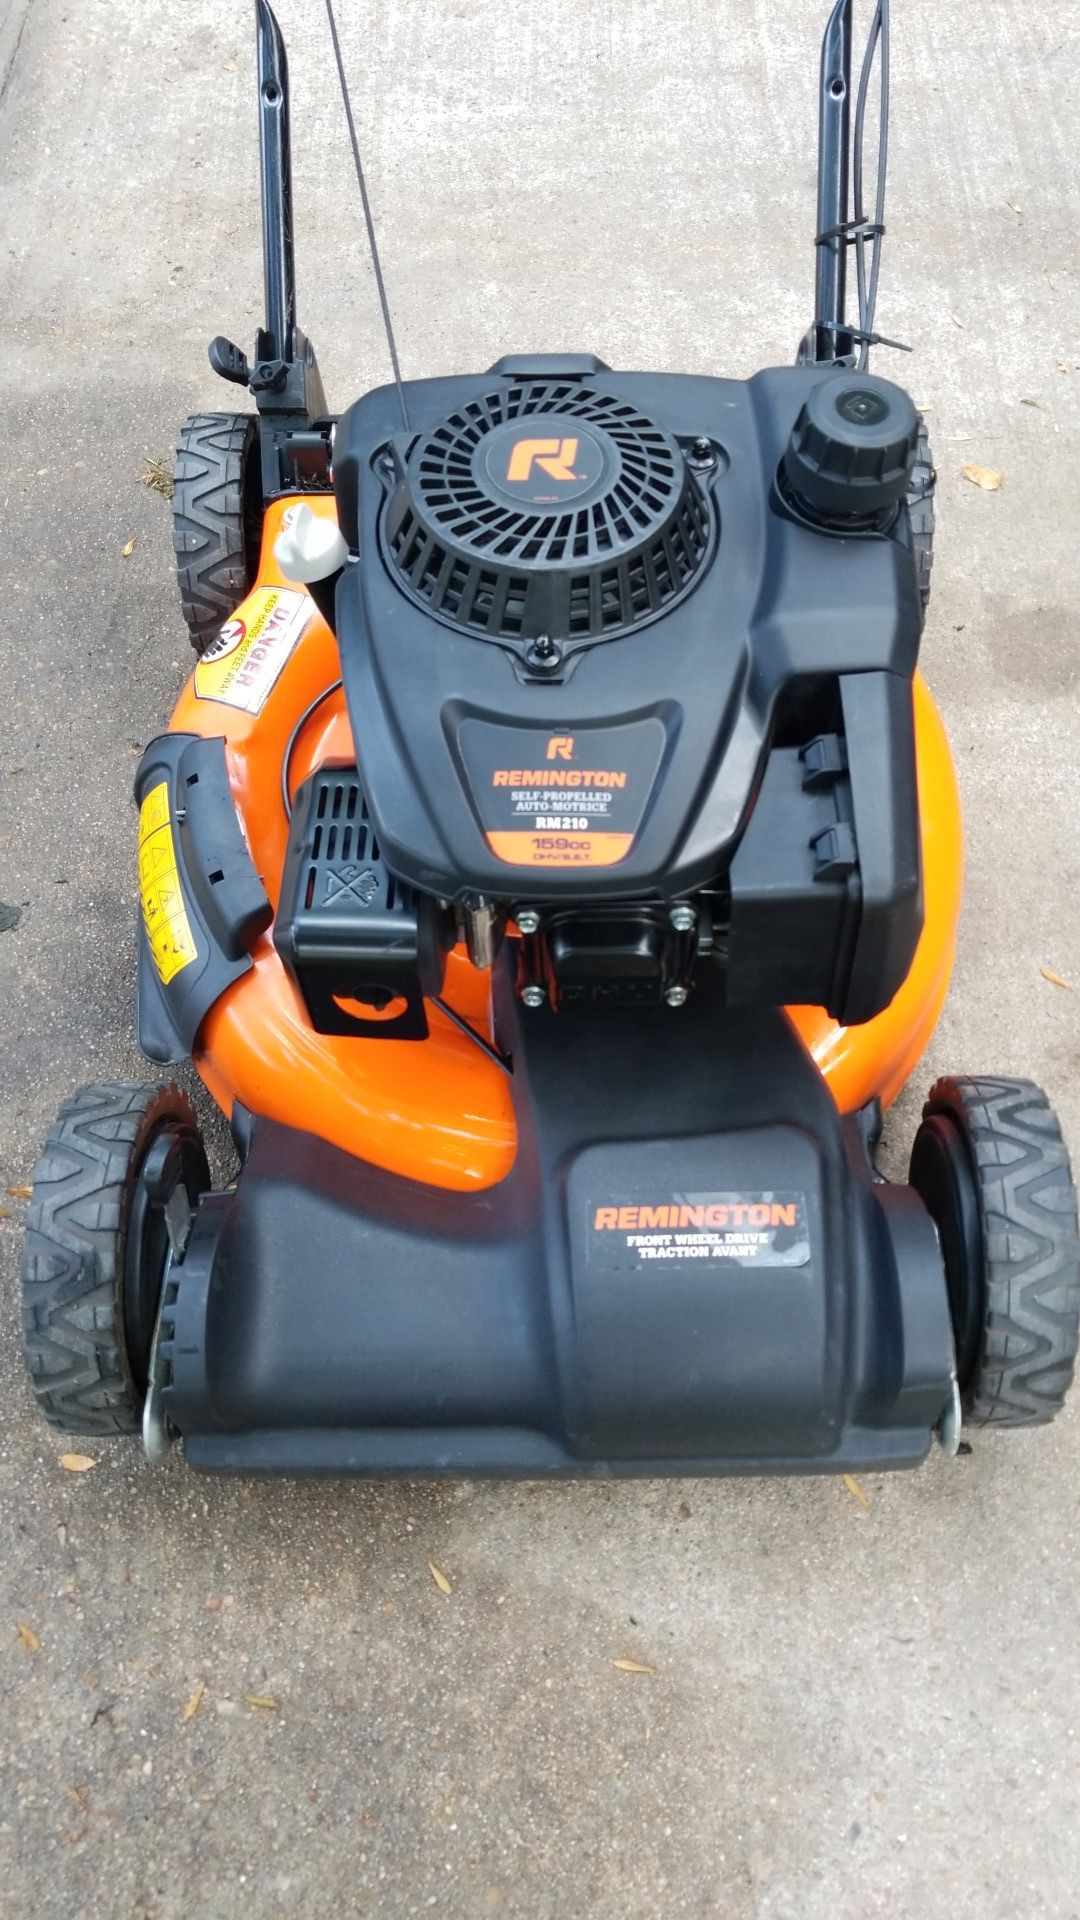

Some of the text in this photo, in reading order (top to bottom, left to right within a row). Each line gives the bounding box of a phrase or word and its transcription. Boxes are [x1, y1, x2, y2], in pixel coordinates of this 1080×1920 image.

[264, 594, 279, 614] KEEP
[248, 614, 266, 639] HANDS
[236, 607, 291, 687] DANGER
[218, 672, 235, 694] AWAY
[492, 769, 627, 788] REMINGTON
[511, 791, 612, 802] SELF-PROPELLED
[515, 802, 608, 813] AUTO-MOTRICE
[535, 817, 588, 829] RM210
[532, 838, 592, 850] 159cc
[594, 1203, 797, 1231] REMINGTON
[627, 1232, 768, 1247] FRONT WHEEL DRIVE
[638, 1245, 758, 1259] TRACTION AVANT
